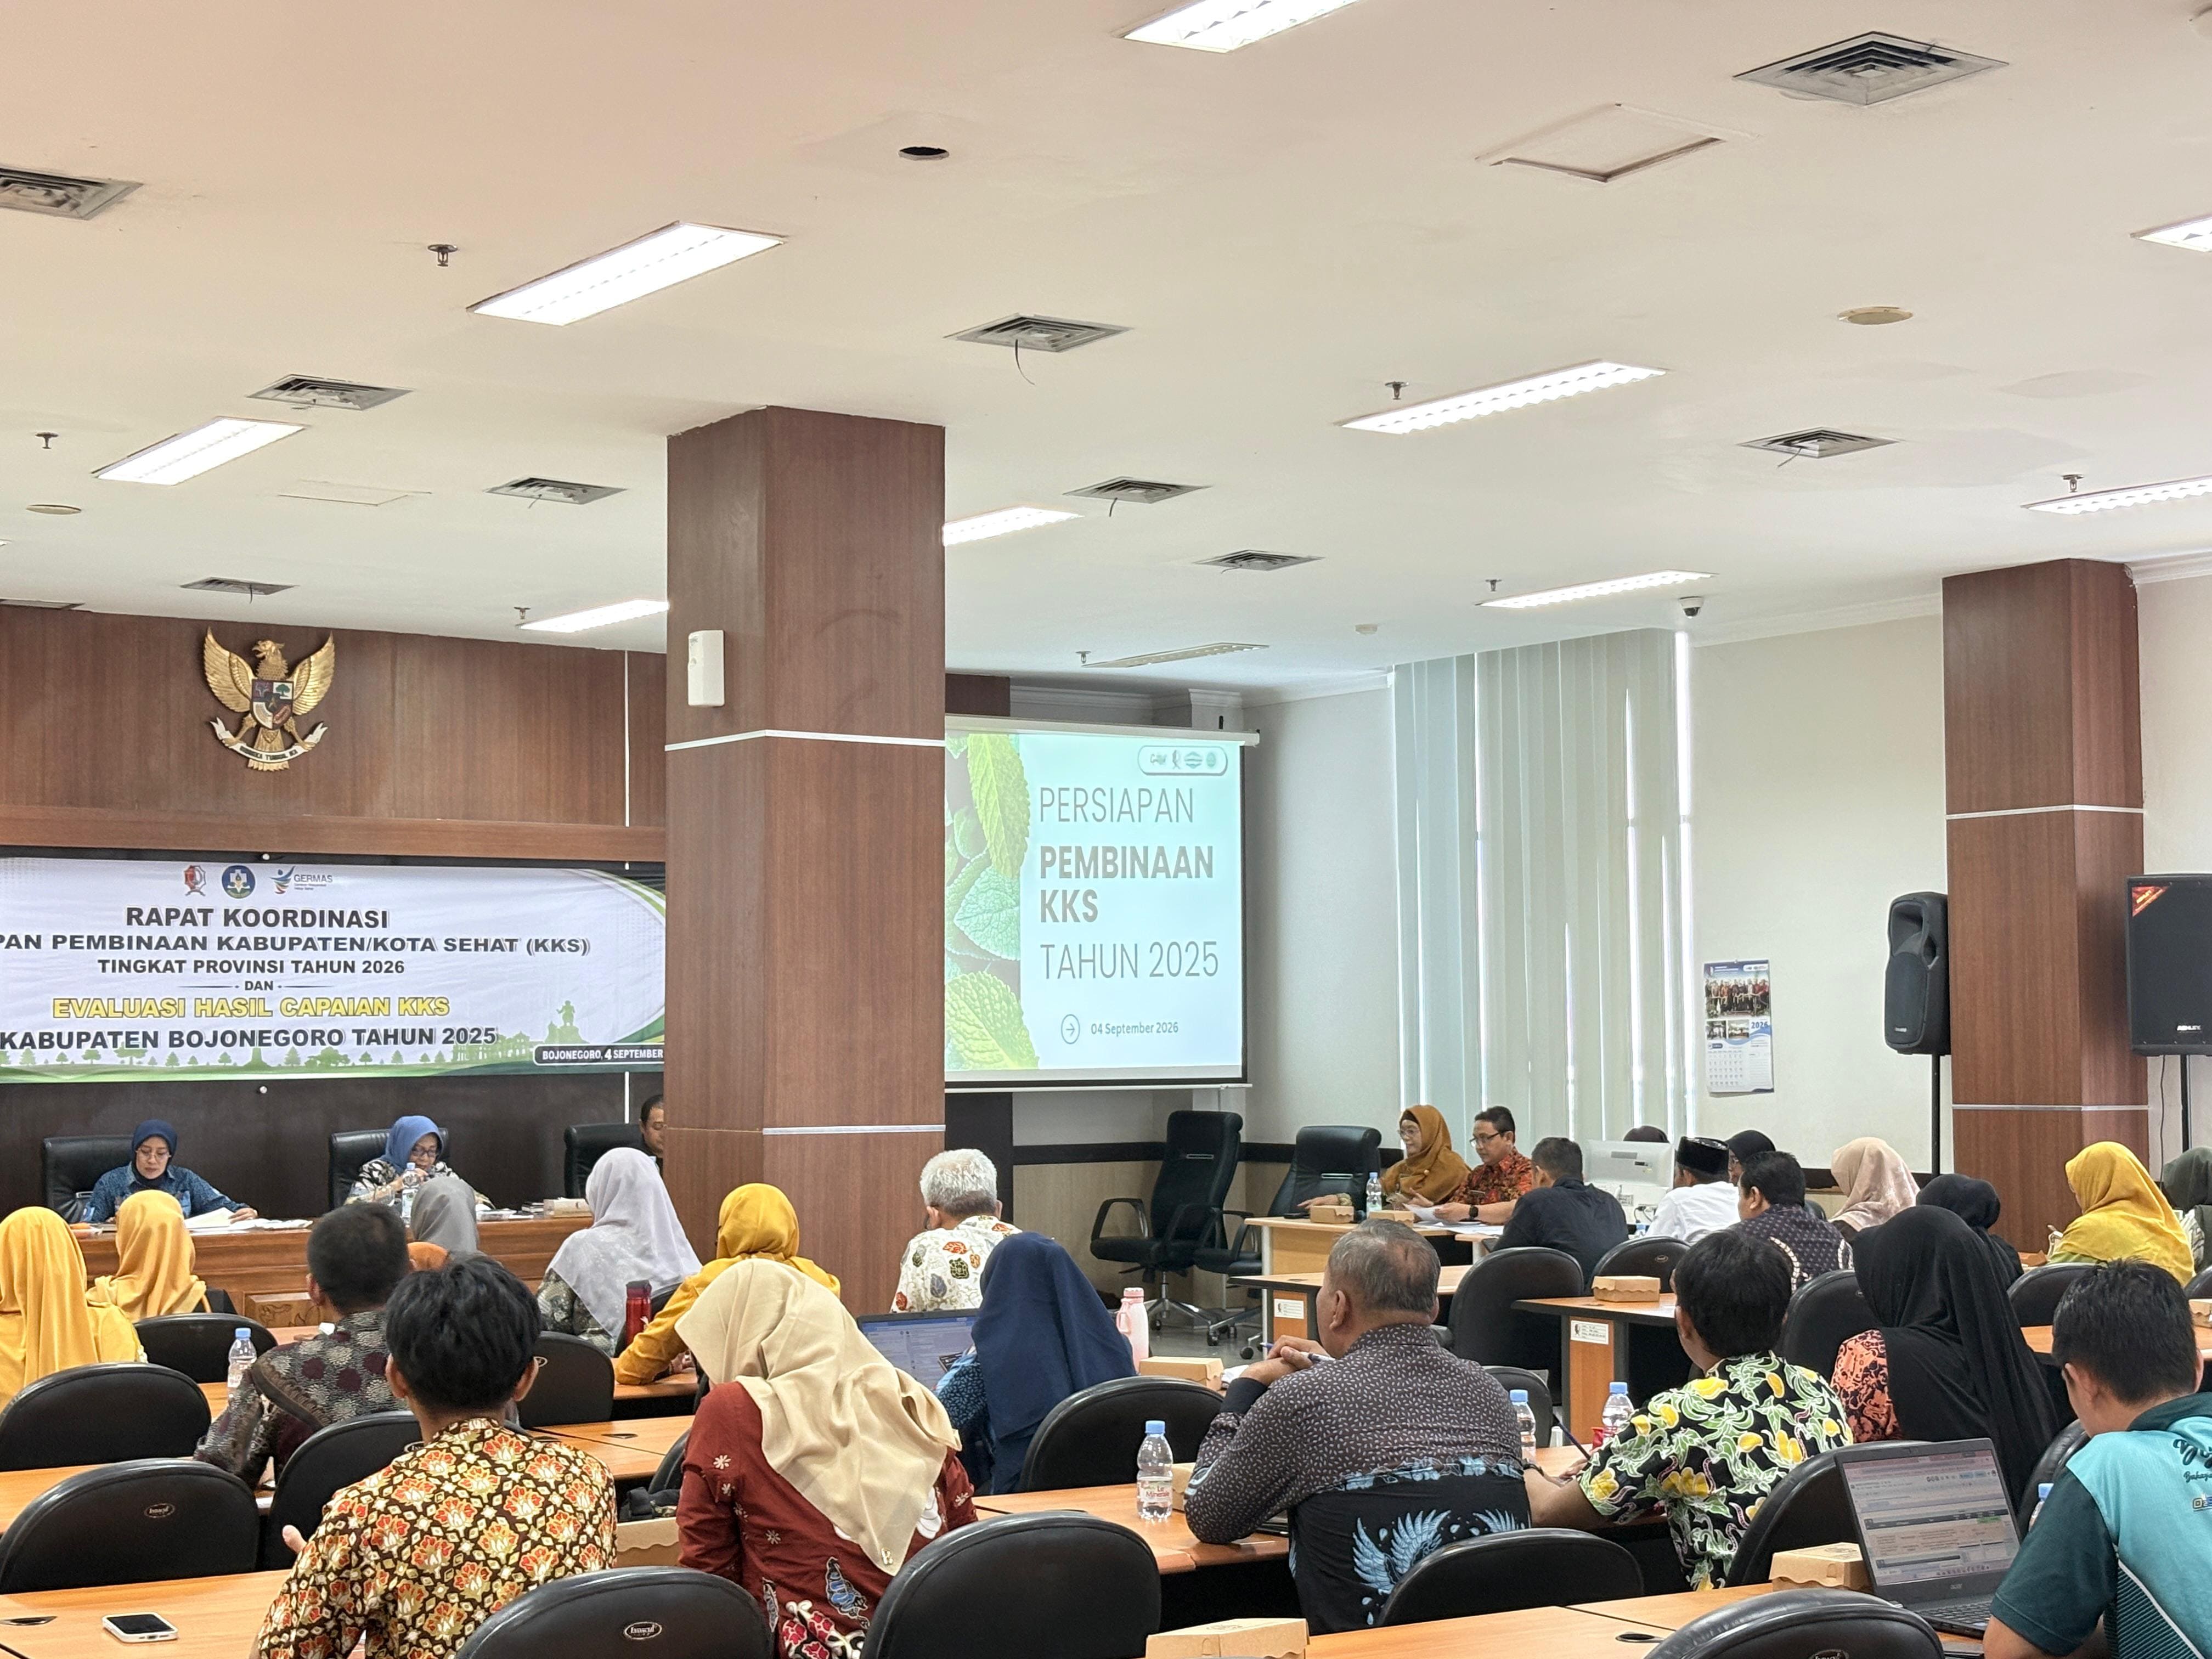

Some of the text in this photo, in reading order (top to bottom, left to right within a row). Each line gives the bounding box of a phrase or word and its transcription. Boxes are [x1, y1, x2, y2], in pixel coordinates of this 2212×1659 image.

[1040, 787, 1193, 823] PERSIAPAN
[1040, 846, 1213, 879] PEMBINAAN
[294, 874, 333, 882] GERMAS
[1040, 889, 1098, 923] KKS
[126, 907, 388, 928] RAPAT KOORDINASI
[52, 935, 207, 950] PEMBINAAN
[218, 936, 436, 952] KABUPATEN/KOTA
[443, 938, 519, 952] SEHAT
[527, 938, 590, 956] (KKS)
[98, 960, 405, 973] TINGKAT PROVINSI TAHUN 2026
[1040, 941, 1218, 979] TAHUN 2025
[245, 981, 274, 991] DAN
[53, 997, 450, 1018] EVALUASI HASIL CAPAIAN KKS
[0, 1028, 496, 1049] KABUPATEN BOJONEGORO TAHUN 2025
[1091, 1022, 1178, 1037] 04 September 2026
[542, 1048, 664, 1060] BOJONEGORO, 4 SEPTEMBER
